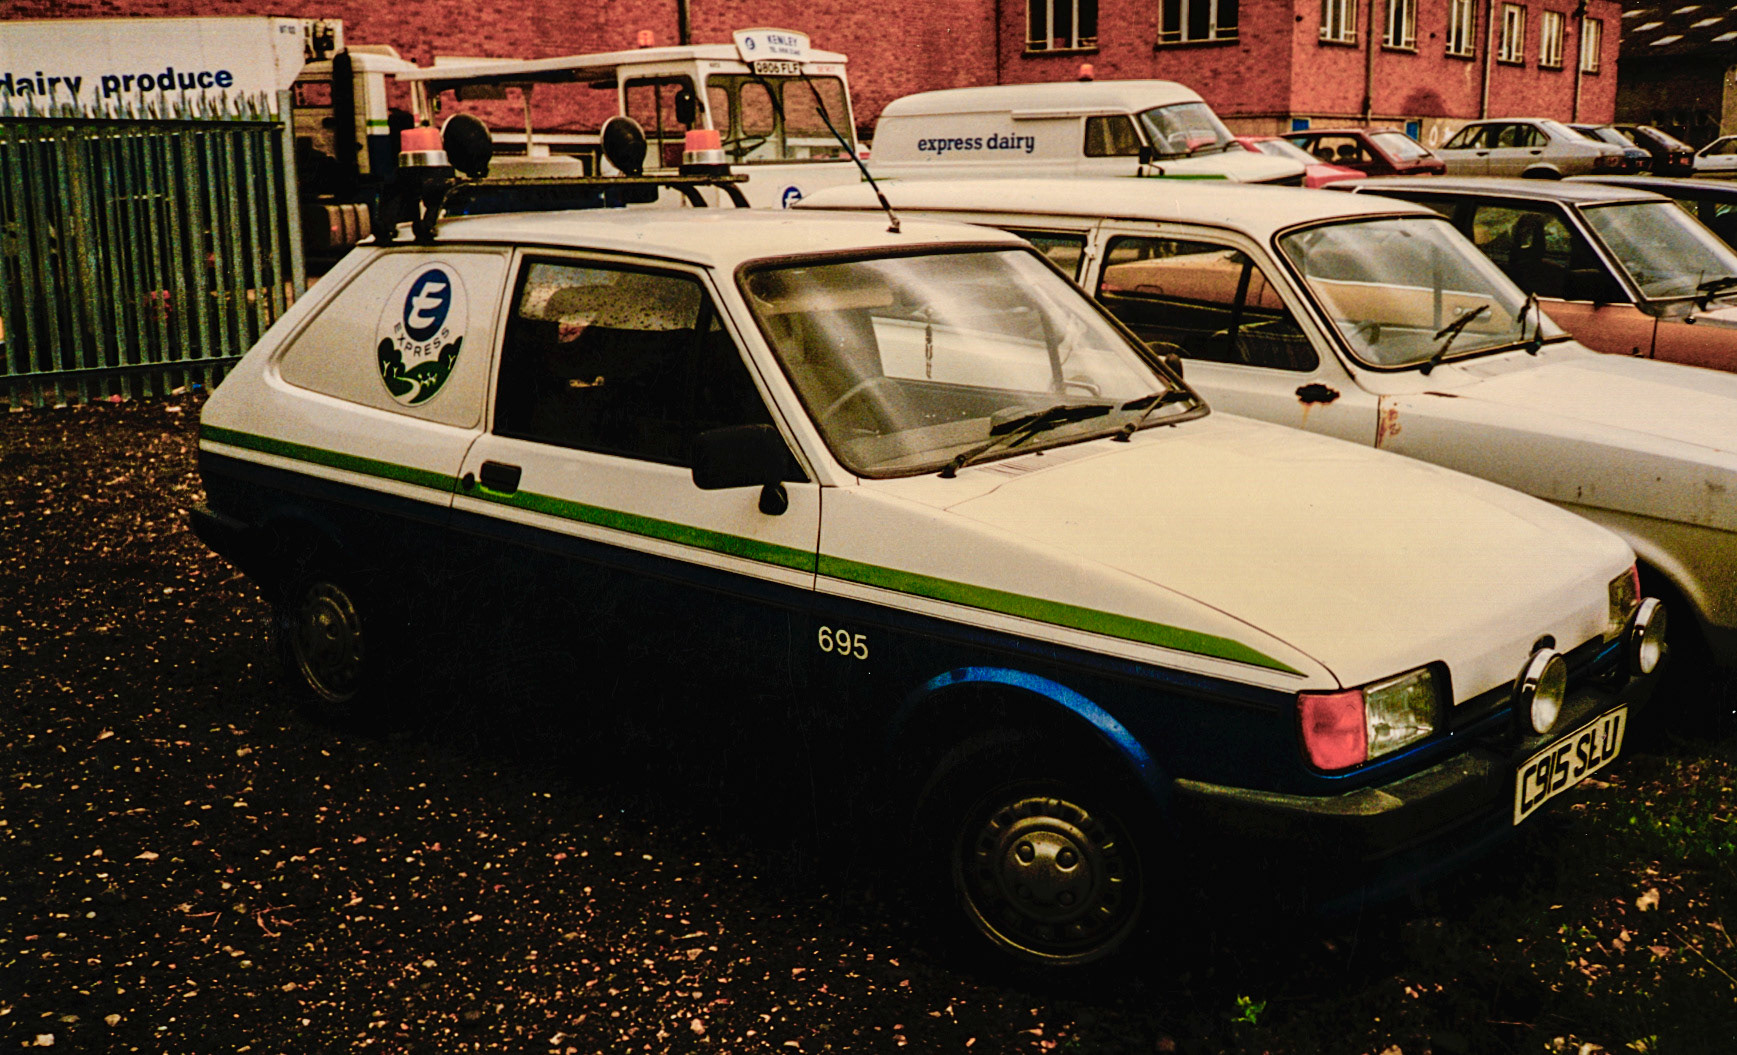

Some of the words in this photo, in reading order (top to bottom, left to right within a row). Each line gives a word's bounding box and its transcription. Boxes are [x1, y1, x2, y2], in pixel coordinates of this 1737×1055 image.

[767, 35, 797, 47] KENLEY
[101, 67, 233, 98] produce
[918, 138, 982, 154] express
[987, 133, 1035, 154] dairy
[394, 322, 450, 357] EXPRESS
[818, 626, 868, 660] 695
[1521, 743, 1572, 815] C915
[1574, 715, 1620, 778] SLU
